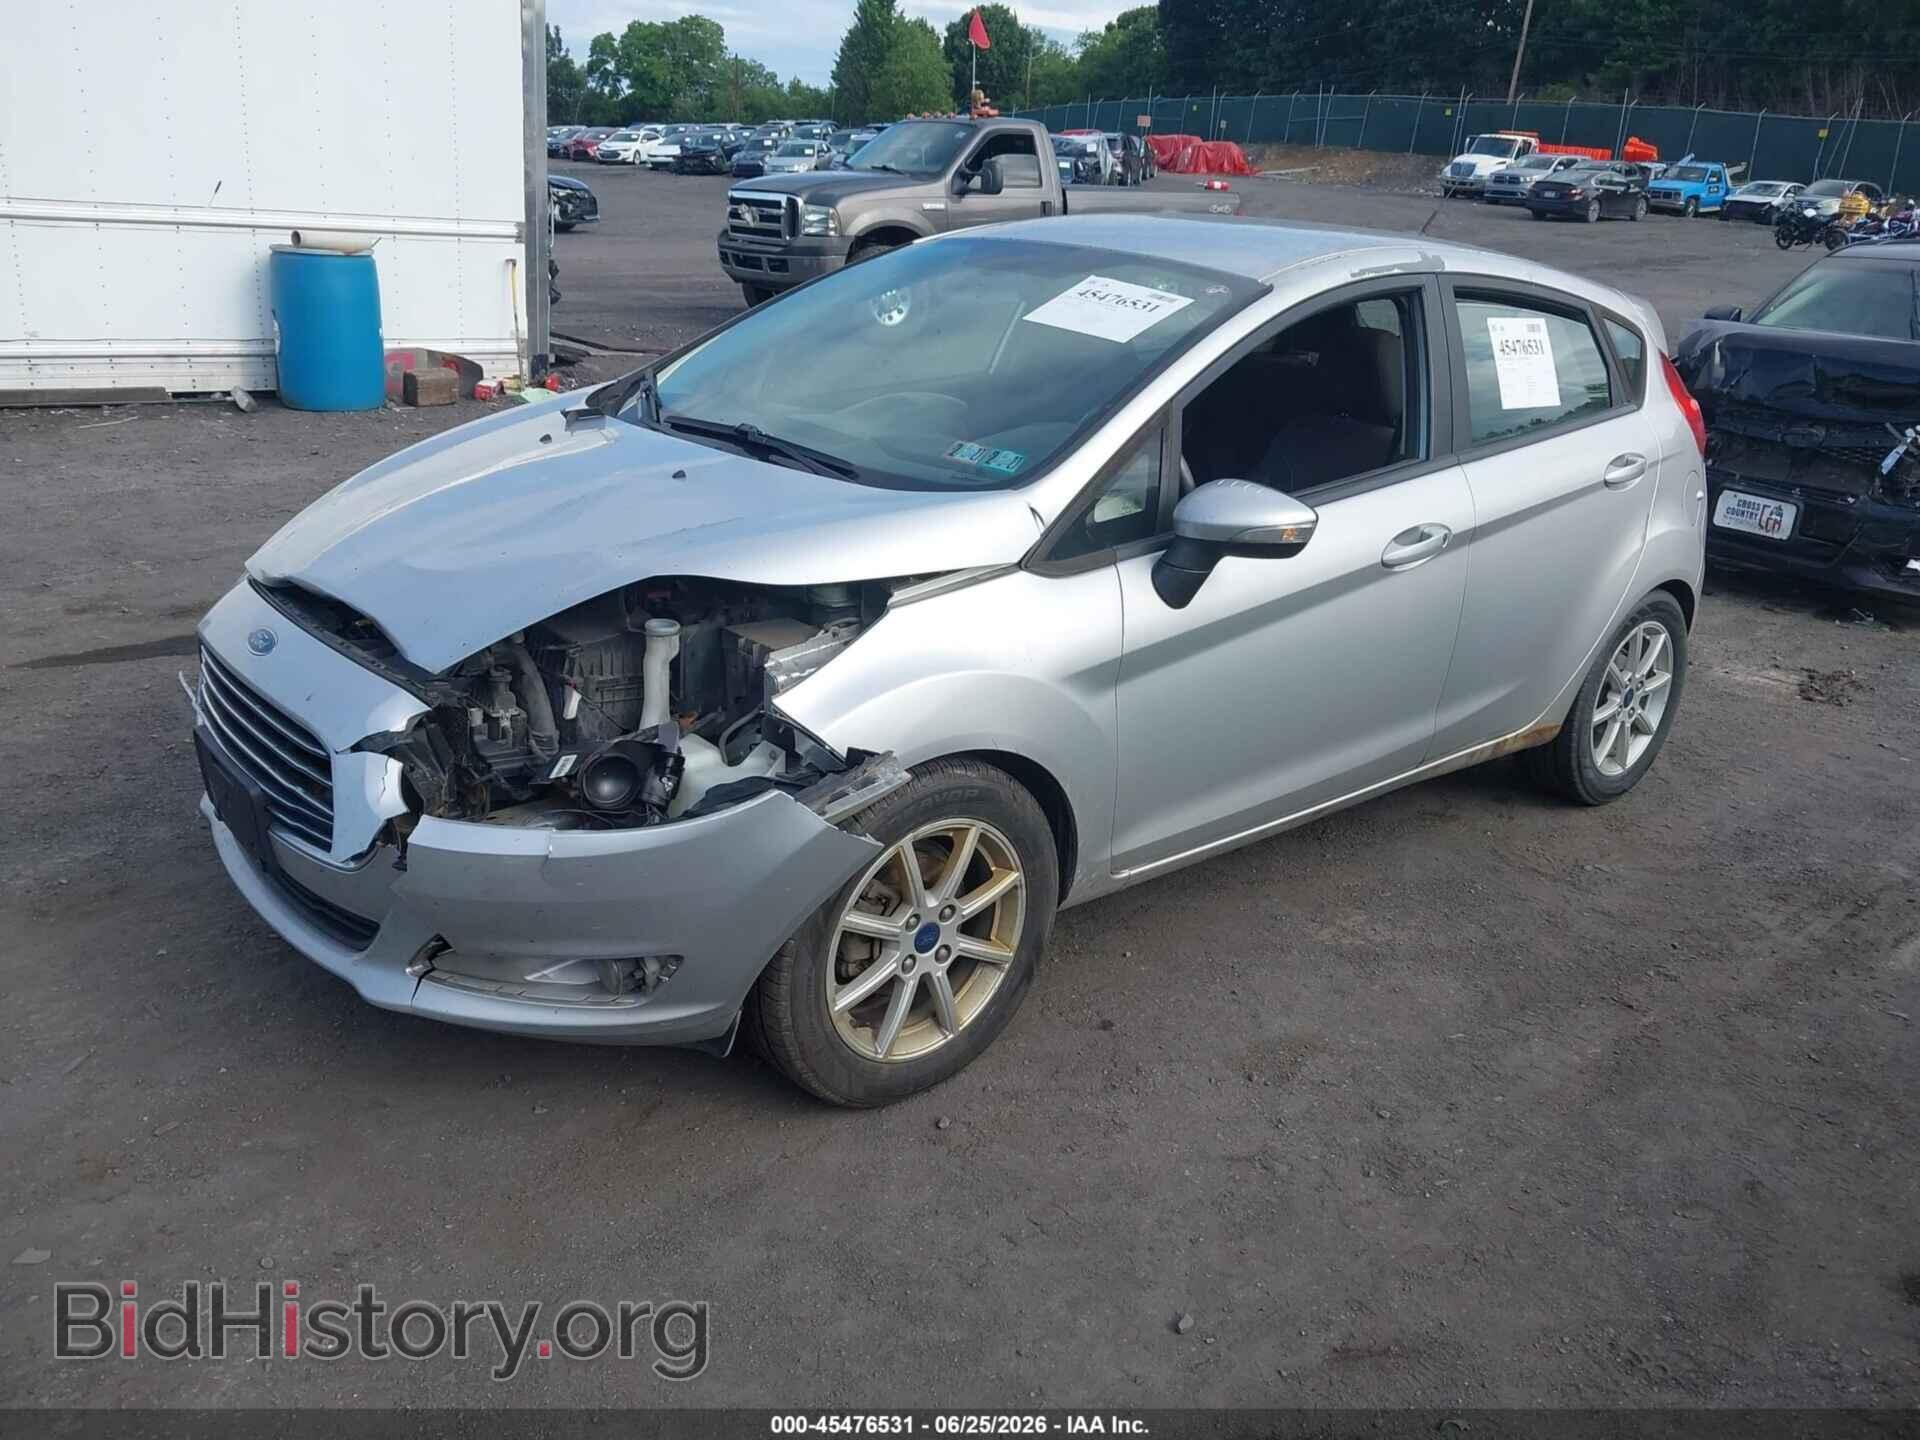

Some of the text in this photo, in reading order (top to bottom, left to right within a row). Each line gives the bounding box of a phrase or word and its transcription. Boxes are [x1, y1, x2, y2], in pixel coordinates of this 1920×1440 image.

[1077, 288, 1160, 312] 45476531
[1499, 338, 1545, 356] 45476531
[1726, 506, 1760, 521] COUNTRY
[1737, 499, 1761, 512] CROSS
